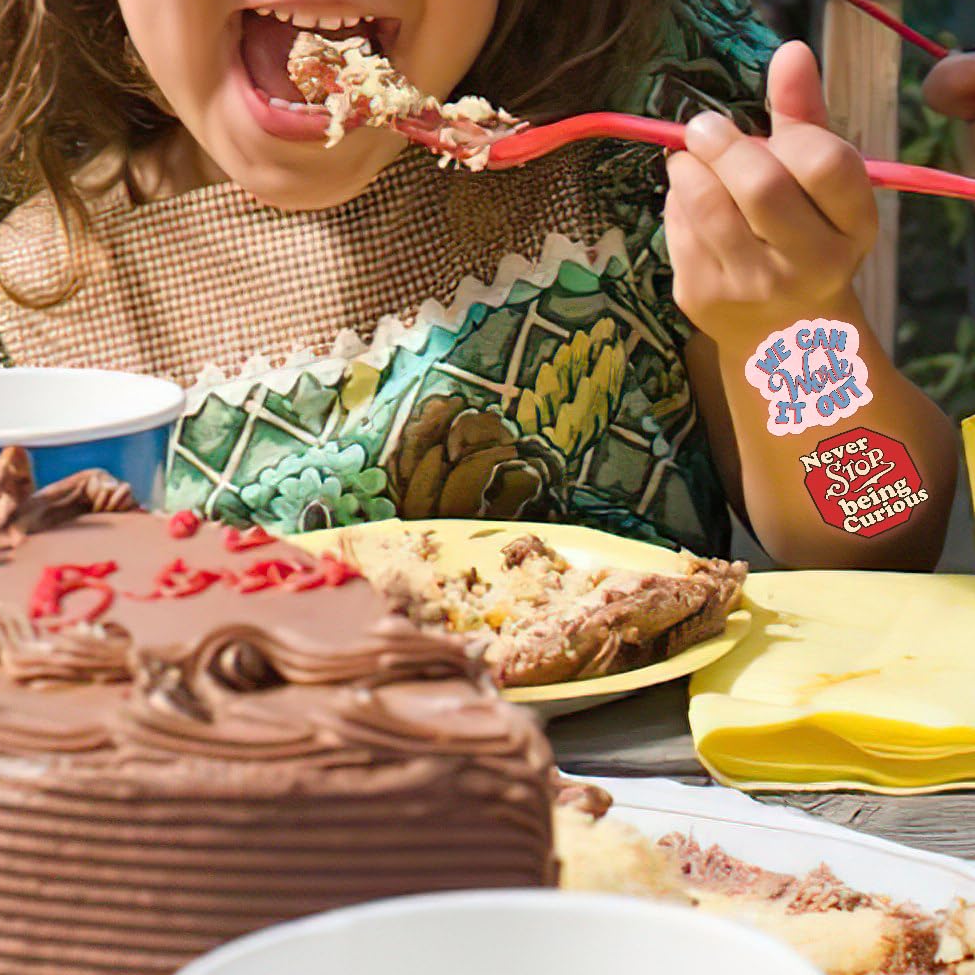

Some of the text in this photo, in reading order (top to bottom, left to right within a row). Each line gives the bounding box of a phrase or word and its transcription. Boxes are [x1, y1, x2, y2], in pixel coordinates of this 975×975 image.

[755, 327, 848, 375] WE CAN
[768, 349, 853, 402] Work
[775, 376, 863, 424] IT OUT
[799, 437, 869, 473] Never
[837, 476, 913, 517] being
[843, 488, 929, 533] Curious
